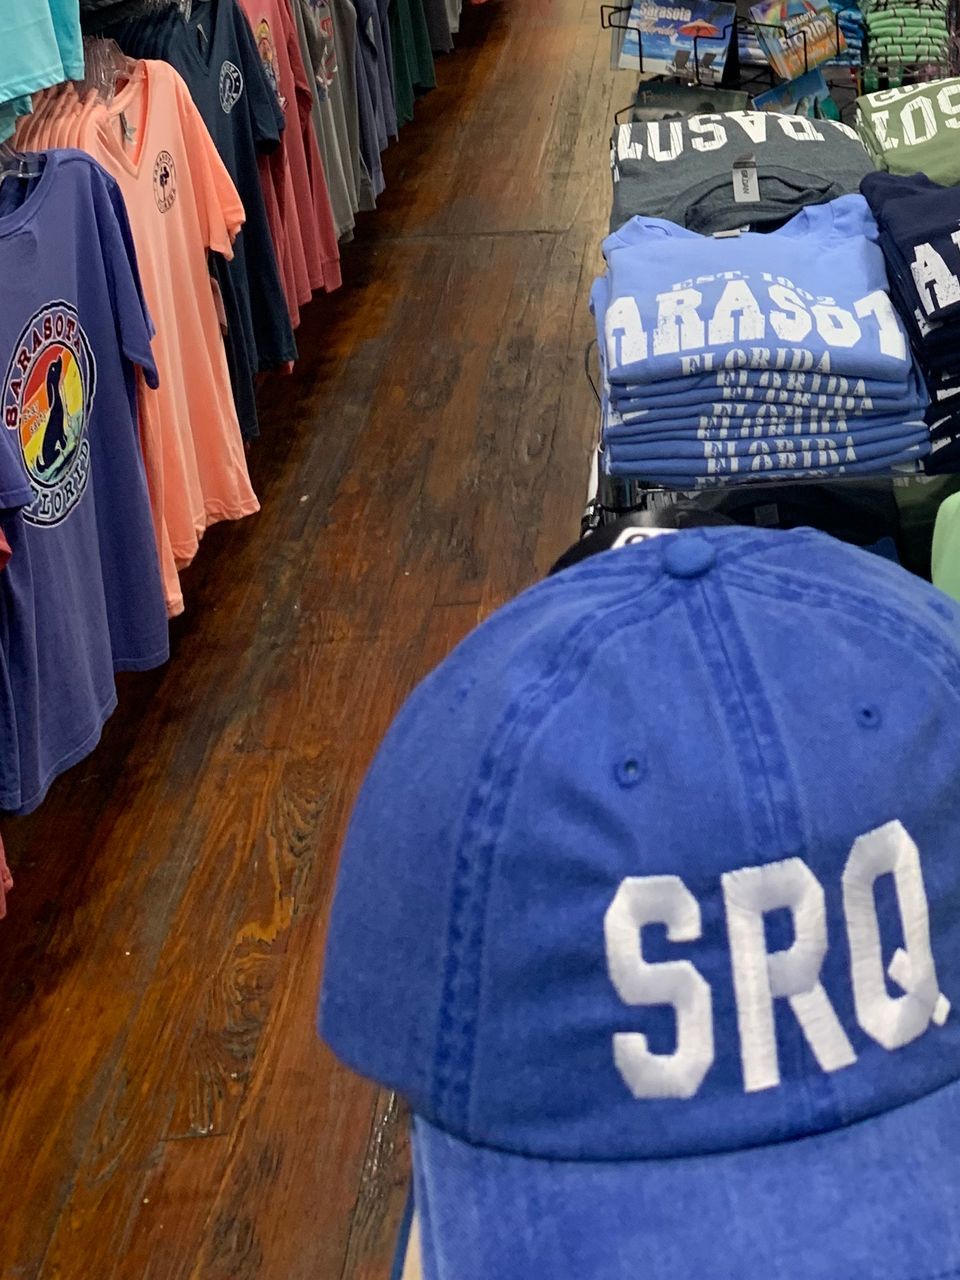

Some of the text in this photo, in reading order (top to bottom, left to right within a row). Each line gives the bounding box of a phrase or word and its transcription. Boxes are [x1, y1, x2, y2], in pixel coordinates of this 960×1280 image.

[638, 0, 692, 23] Sarasota
[777, 19, 832, 50] FLORIDA
[680, 346, 832, 376] FLORIDA
[604, 818, 952, 1101] SRQ
